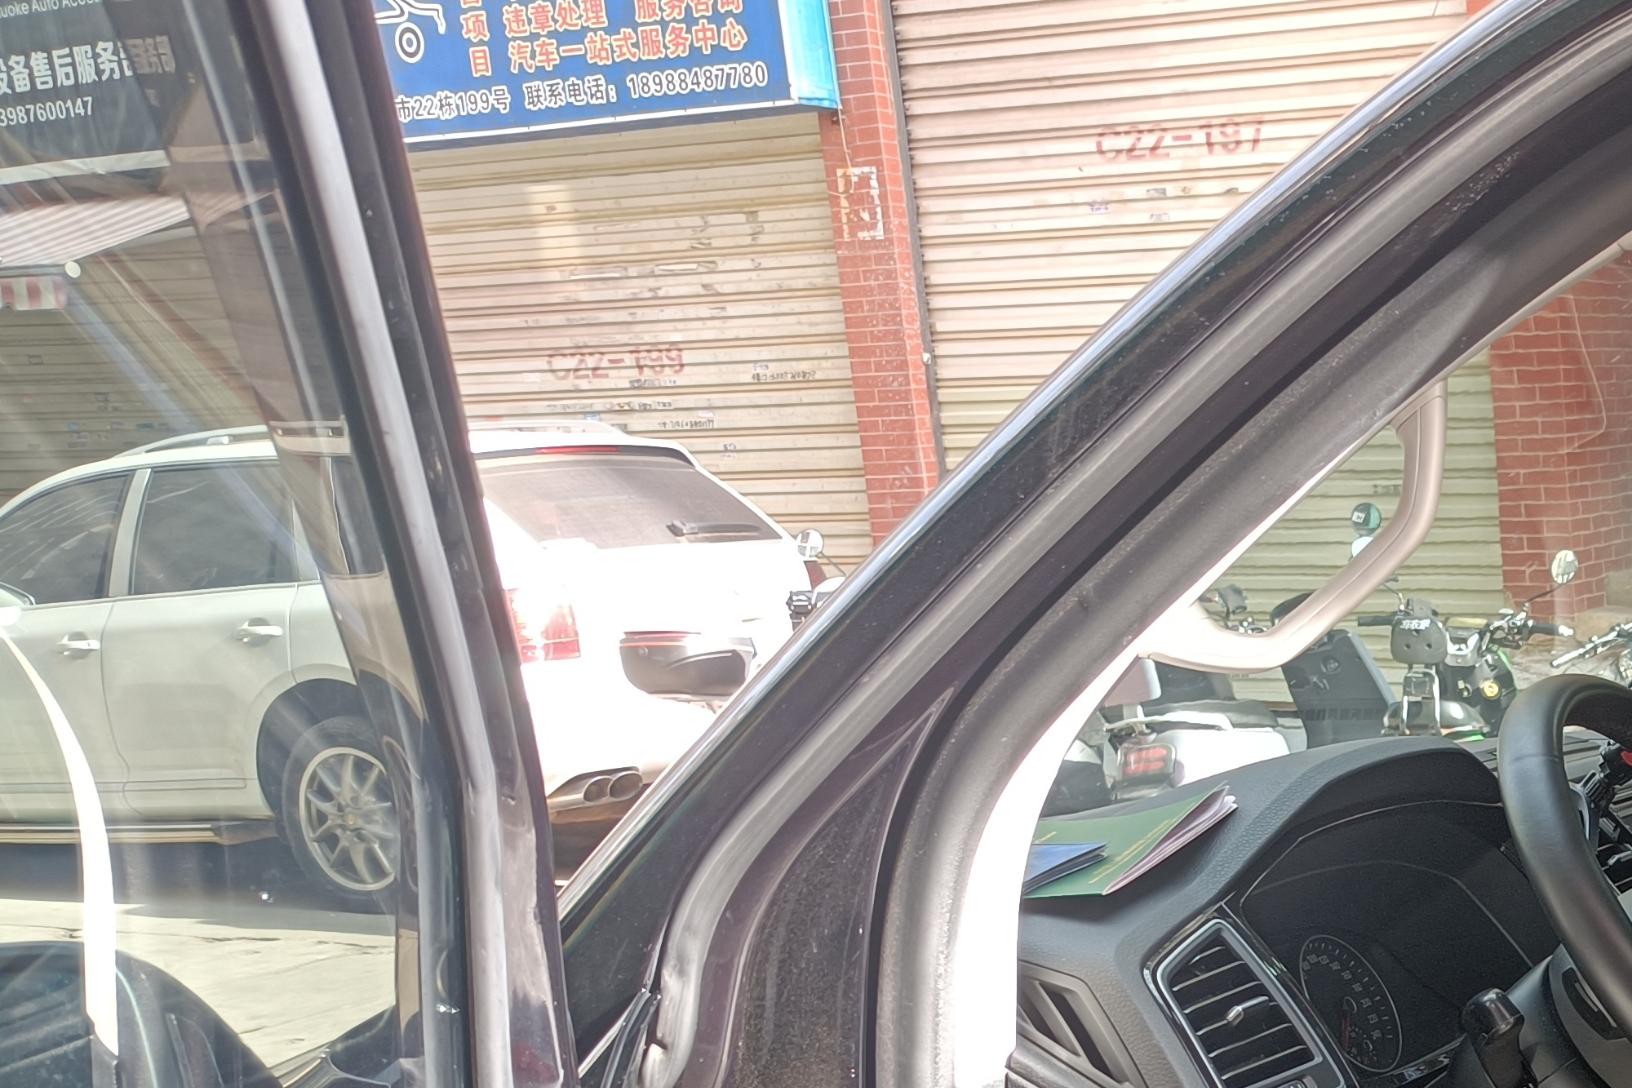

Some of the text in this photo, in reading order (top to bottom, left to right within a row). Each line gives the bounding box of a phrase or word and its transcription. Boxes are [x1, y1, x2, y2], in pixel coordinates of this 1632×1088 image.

[0, 2, 30, 19] uoke
[32, 0, 59, 14] Auto
[504, 0, 608, 37] 违章处理
[460, 0, 492, 77] 项目
[508, 18, 747, 73] 汽车一站式服务中心
[627, 61, 767, 99] 18988487780
